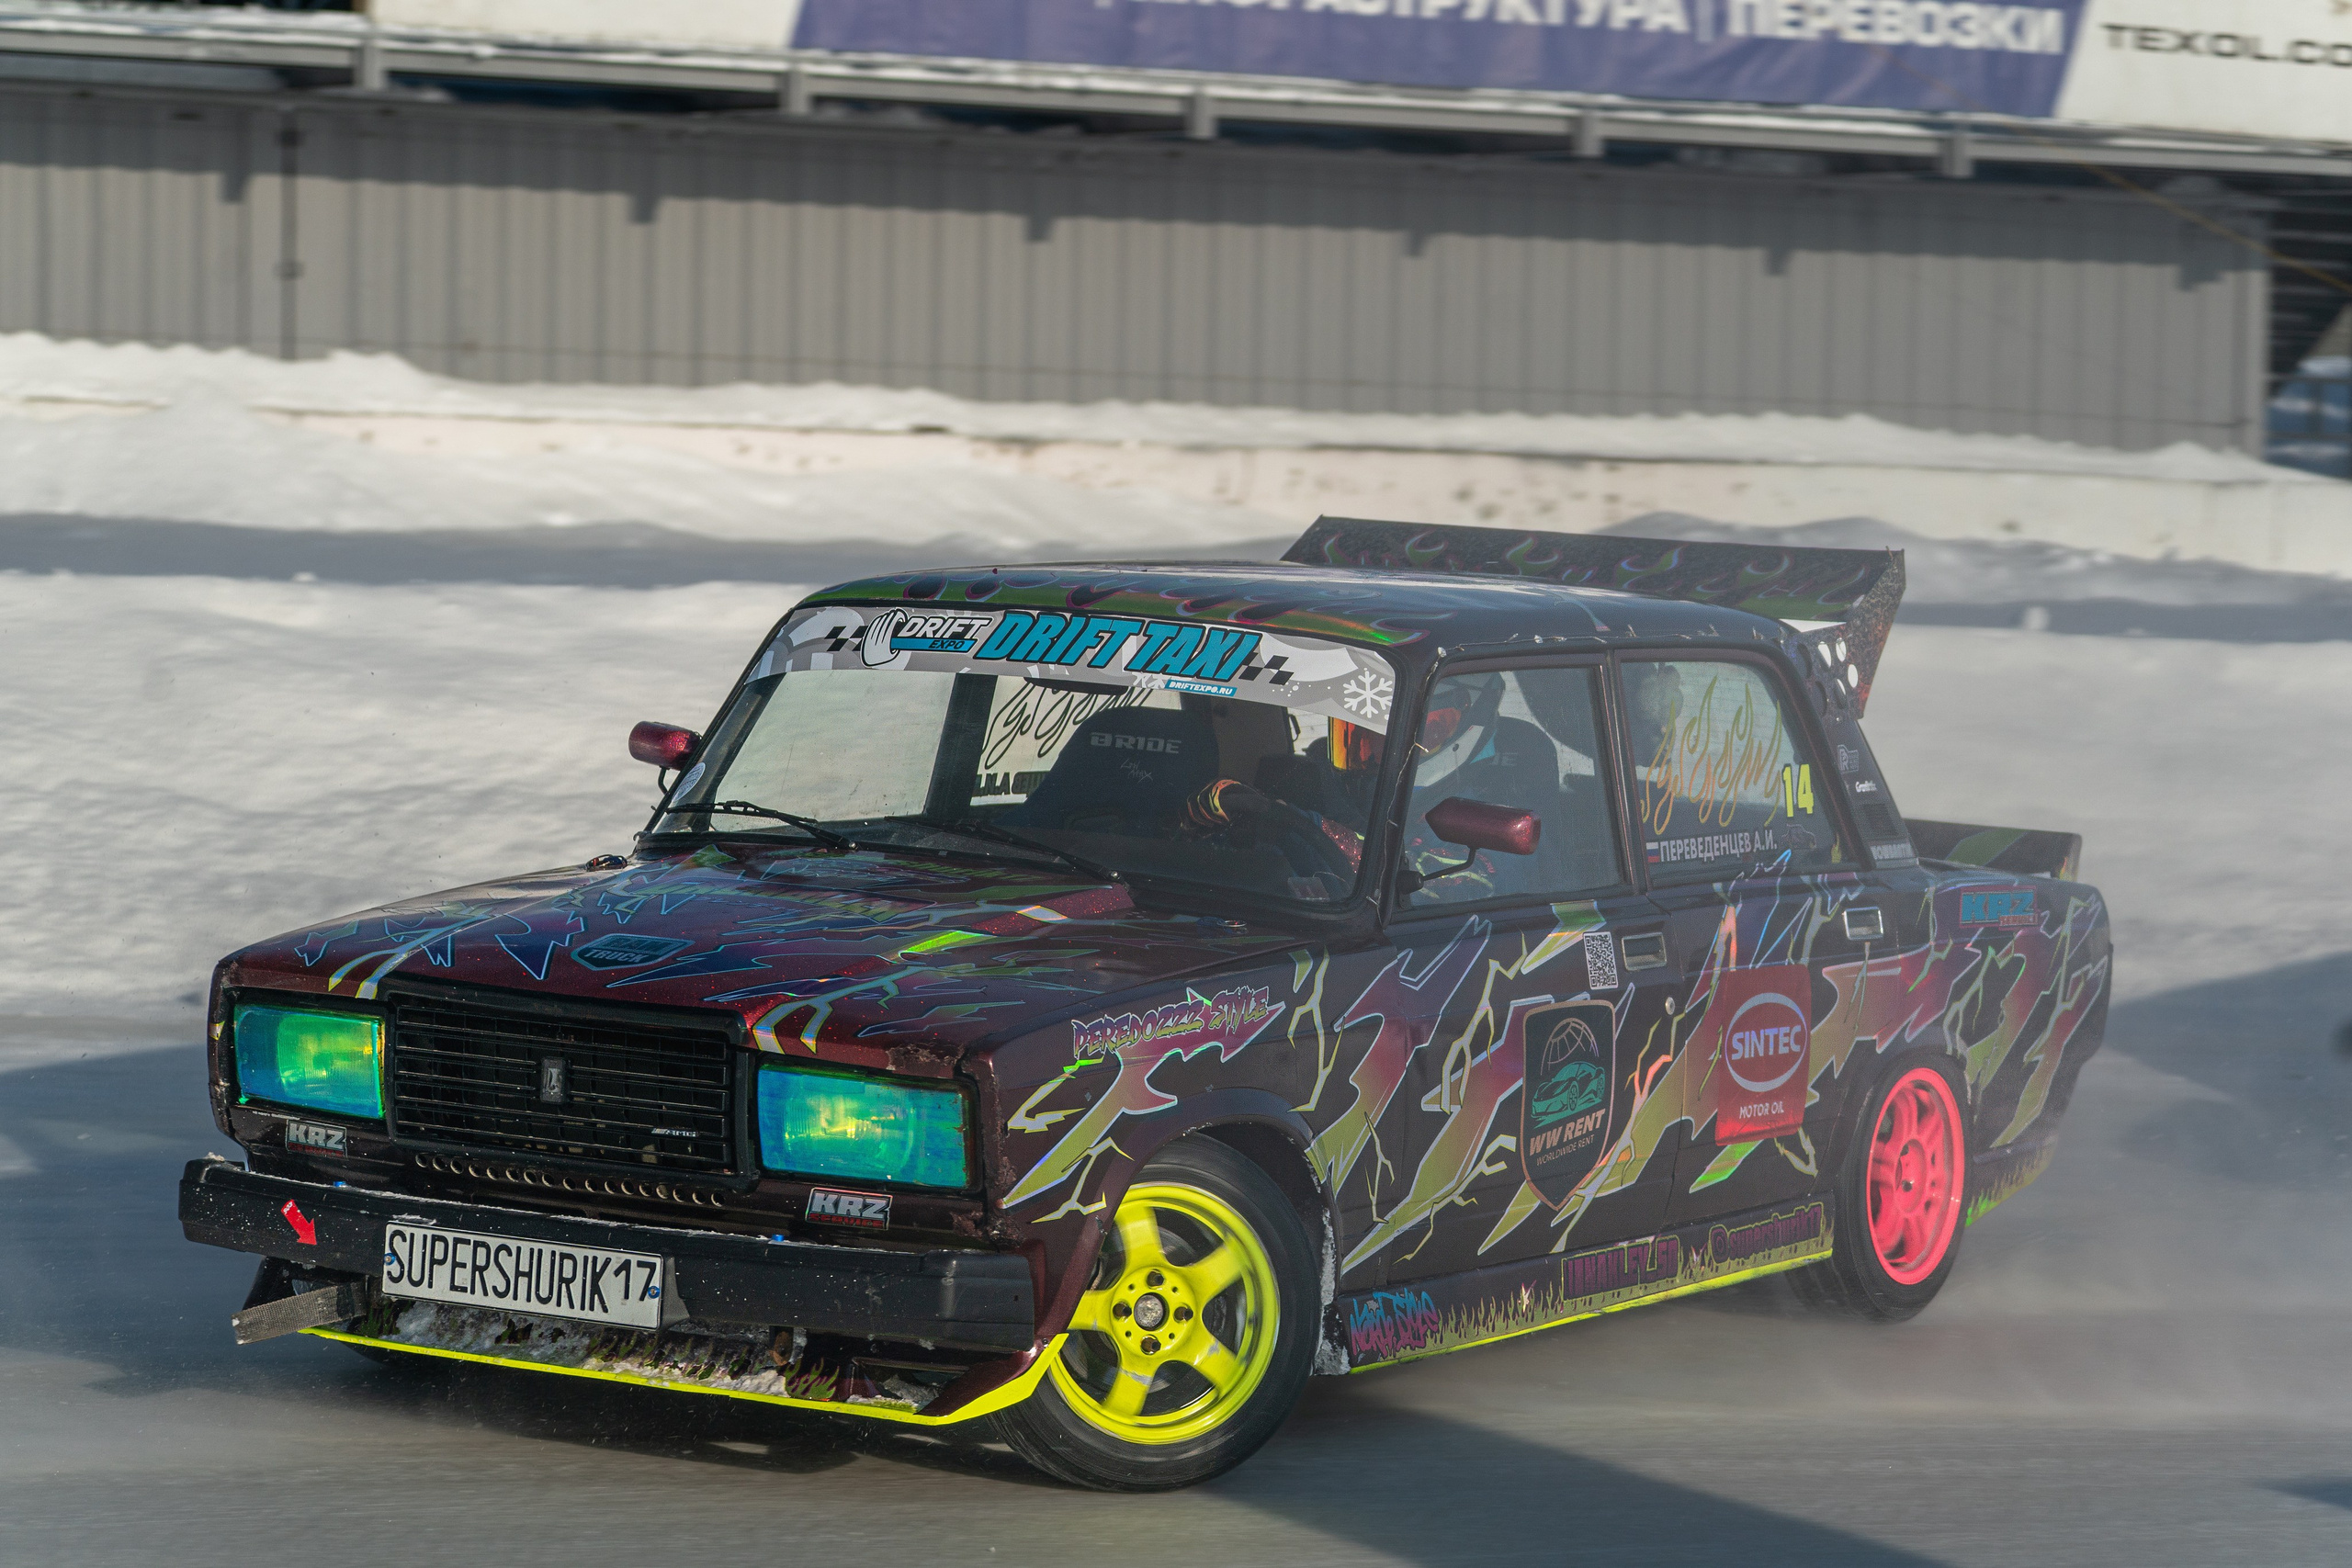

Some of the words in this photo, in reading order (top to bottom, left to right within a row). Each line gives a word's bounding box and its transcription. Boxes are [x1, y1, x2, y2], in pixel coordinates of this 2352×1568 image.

[1728, 0, 2064, 55] ПЕРЕВОЗКИ
[901, 617, 990, 639] DRIFT
[929, 638, 966, 650] EXPO
[974, 610, 1143, 667] DRIFT
[1125, 621, 1262, 682] TAXI
[1169, 681, 1233, 695] DRIFTEXPO.RU
[1783, 763, 1815, 818] 14
[1660, 831, 1751, 863] ПЕРЕВЕДЕНЦЕВ
[1753, 829, 1778, 852] А.И.
[584, 949, 650, 964] TRUCK
[1072, 999, 1205, 1058] PEREDOZZZ
[1210, 987, 1270, 1034] STYLE
[1732, 1025, 1802, 1060] SINTEC
[1739, 1102, 1770, 1119] MOTOR
[1771, 1100, 1784, 1114] OIL
[288, 1122, 345, 1149] KRZ
[1530, 1126, 1563, 1156] WW
[1564, 1108, 1606, 1143] RENT
[1537, 1142, 1577, 1166] WORLDWIDE
[1577, 1134, 1595, 1148] RENT
[811, 1192, 889, 1221] KRZ
